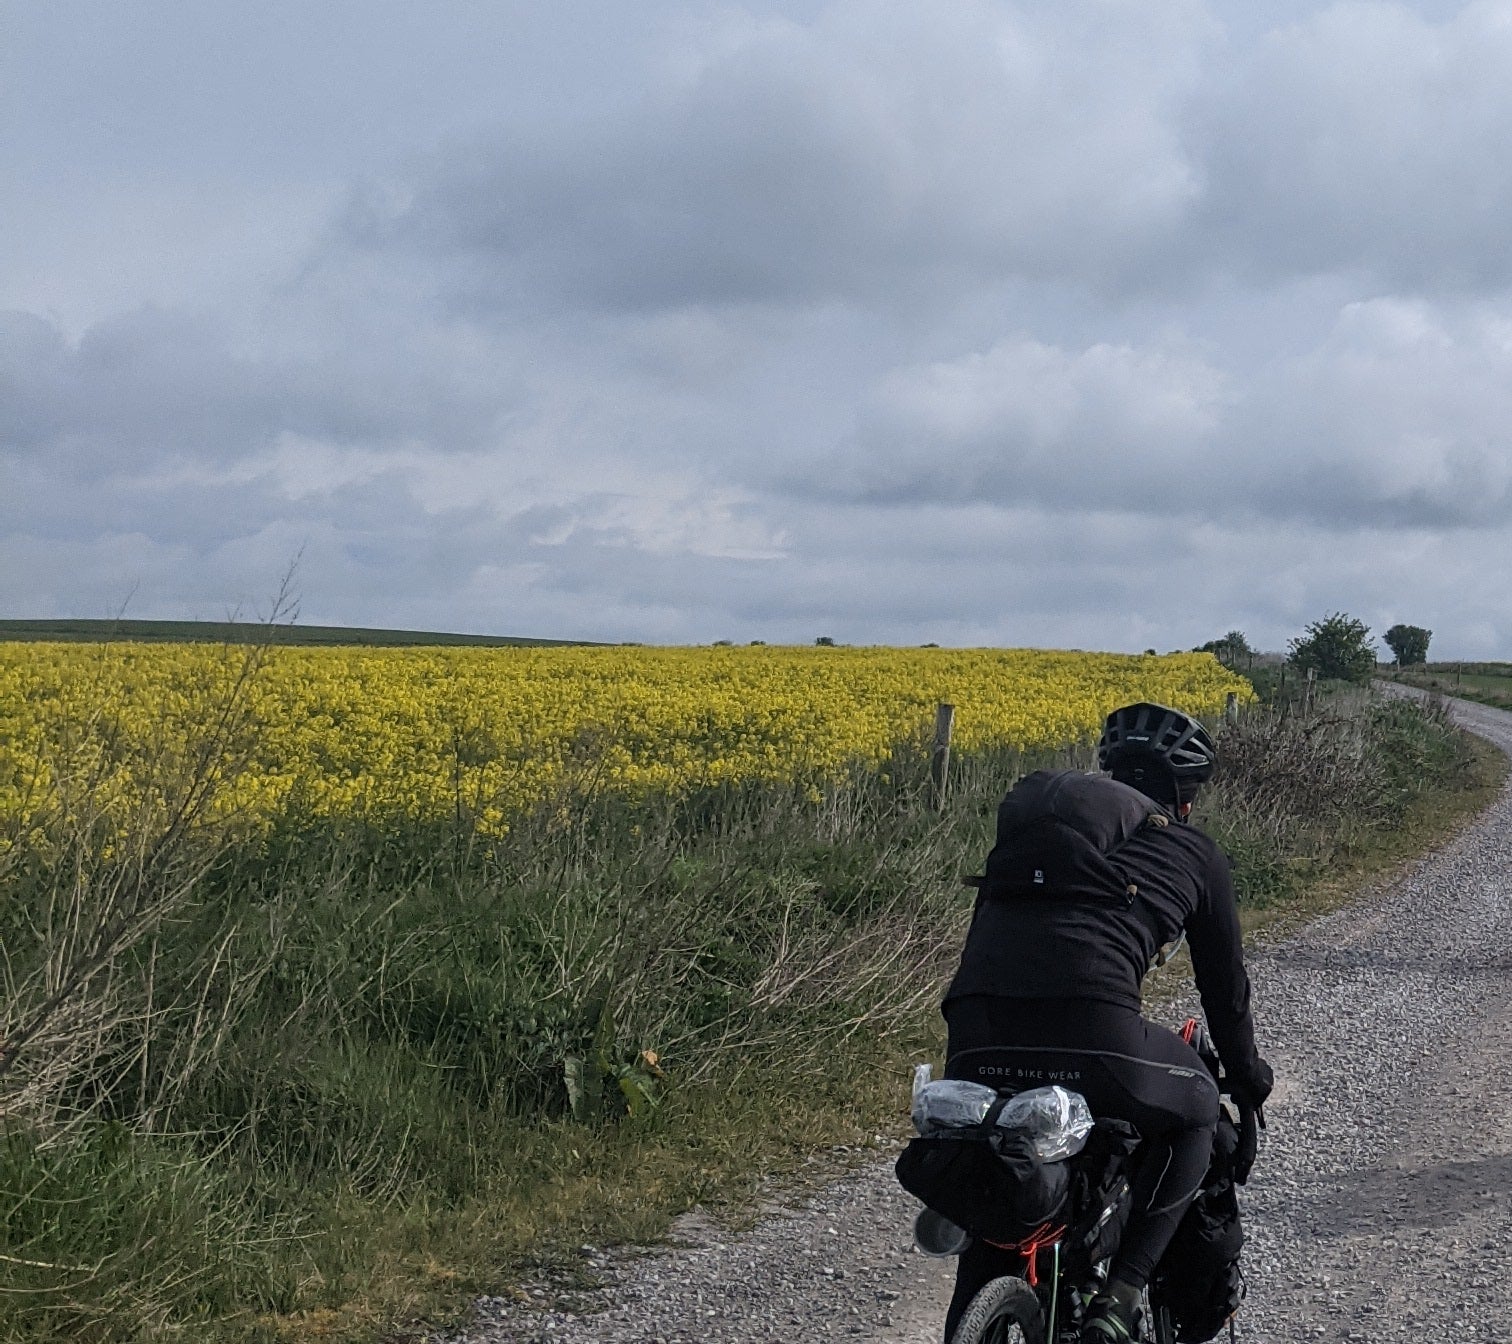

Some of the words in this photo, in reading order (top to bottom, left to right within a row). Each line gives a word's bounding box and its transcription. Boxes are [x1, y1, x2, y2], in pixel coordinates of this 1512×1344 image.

[979, 1067, 1011, 1075] GORE
[1017, 1069, 1043, 1079] BIKE
[1048, 1071, 1081, 1080] WEAR
